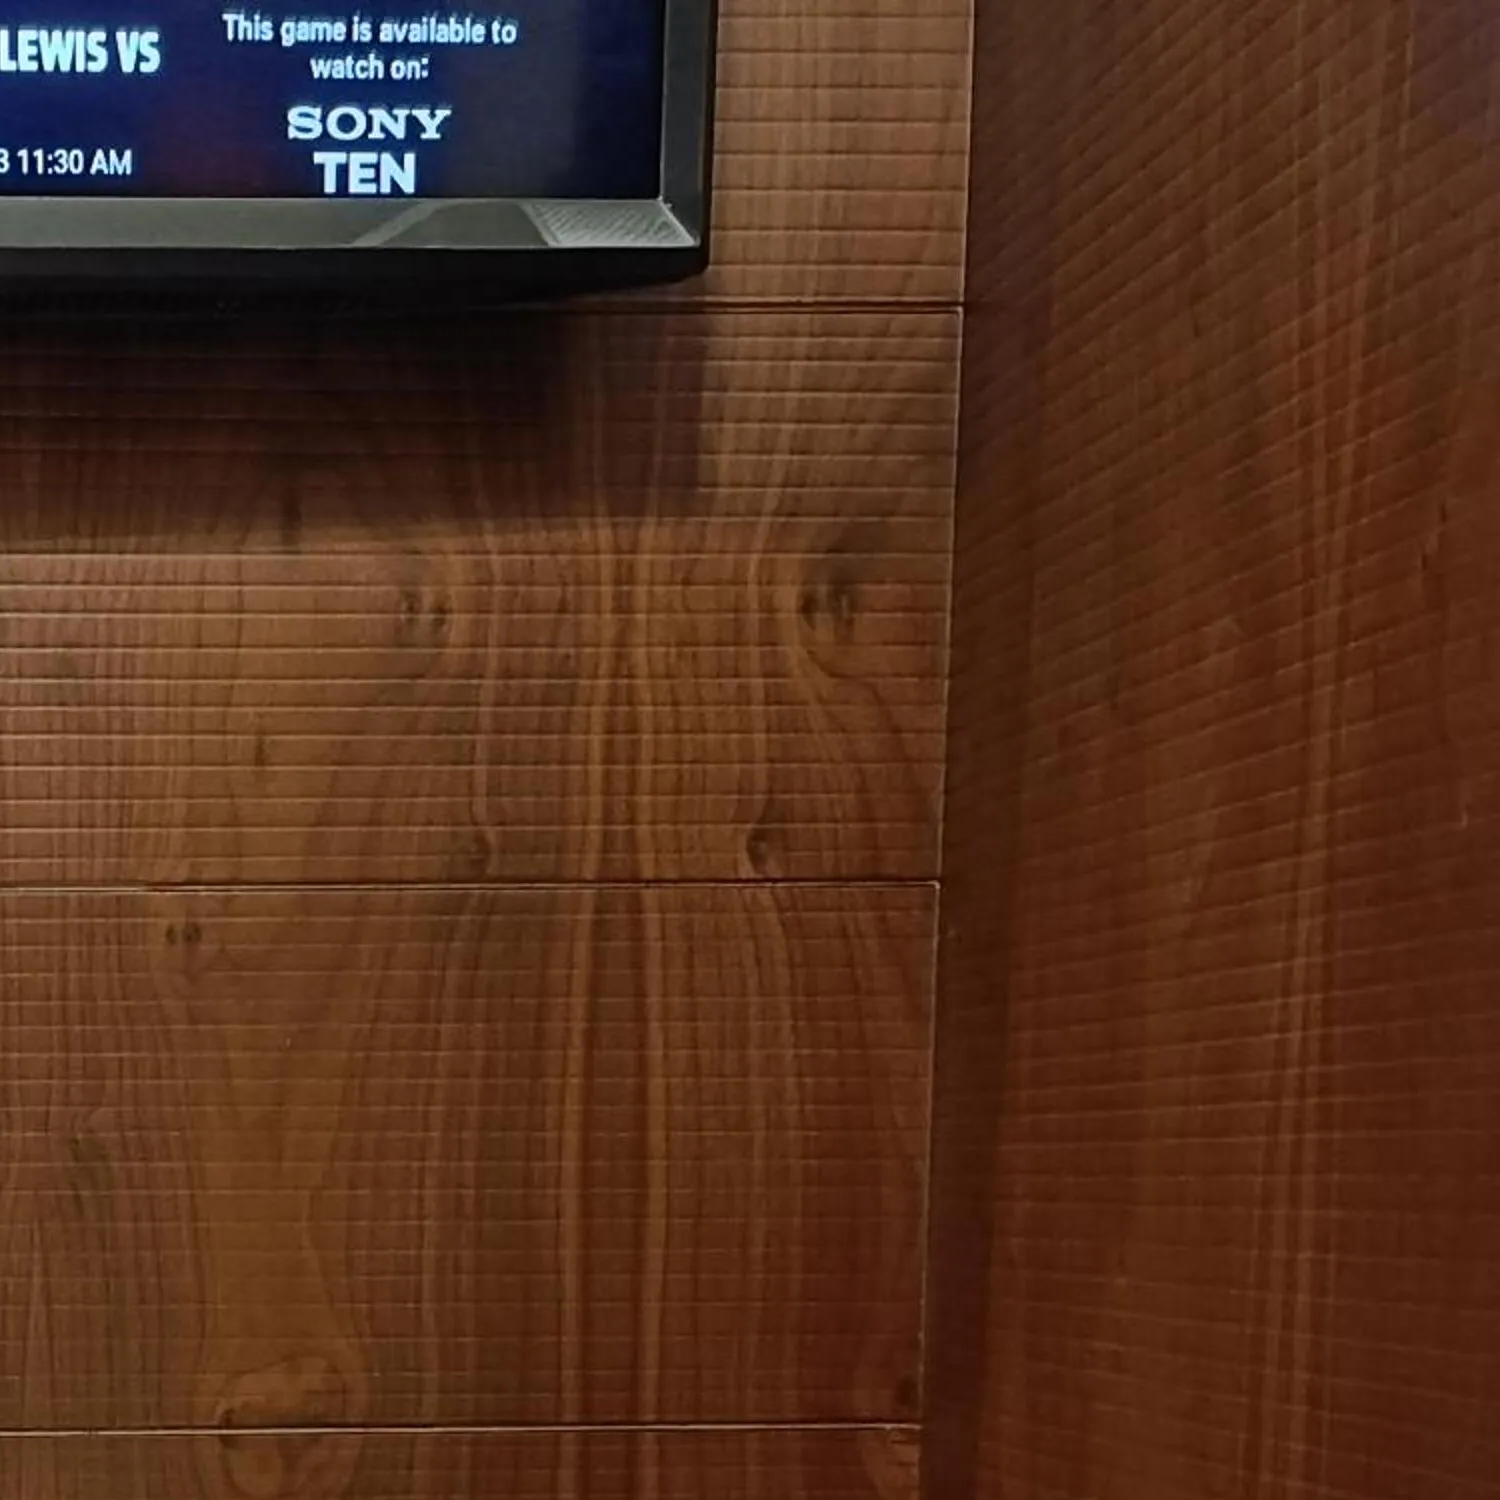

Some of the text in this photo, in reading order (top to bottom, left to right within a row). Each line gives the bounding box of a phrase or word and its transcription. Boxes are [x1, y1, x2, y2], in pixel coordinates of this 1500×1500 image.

[222, 13, 518, 46] This game is available to
[0, 29, 109, 73] LEWIS
[115, 31, 161, 73] VS
[310, 53, 429, 79] watch on:
[287, 105, 452, 140] SONY
[16, 149, 85, 175] 11:30
[89, 149, 133, 175] AM
[313, 152, 415, 193] TEN
